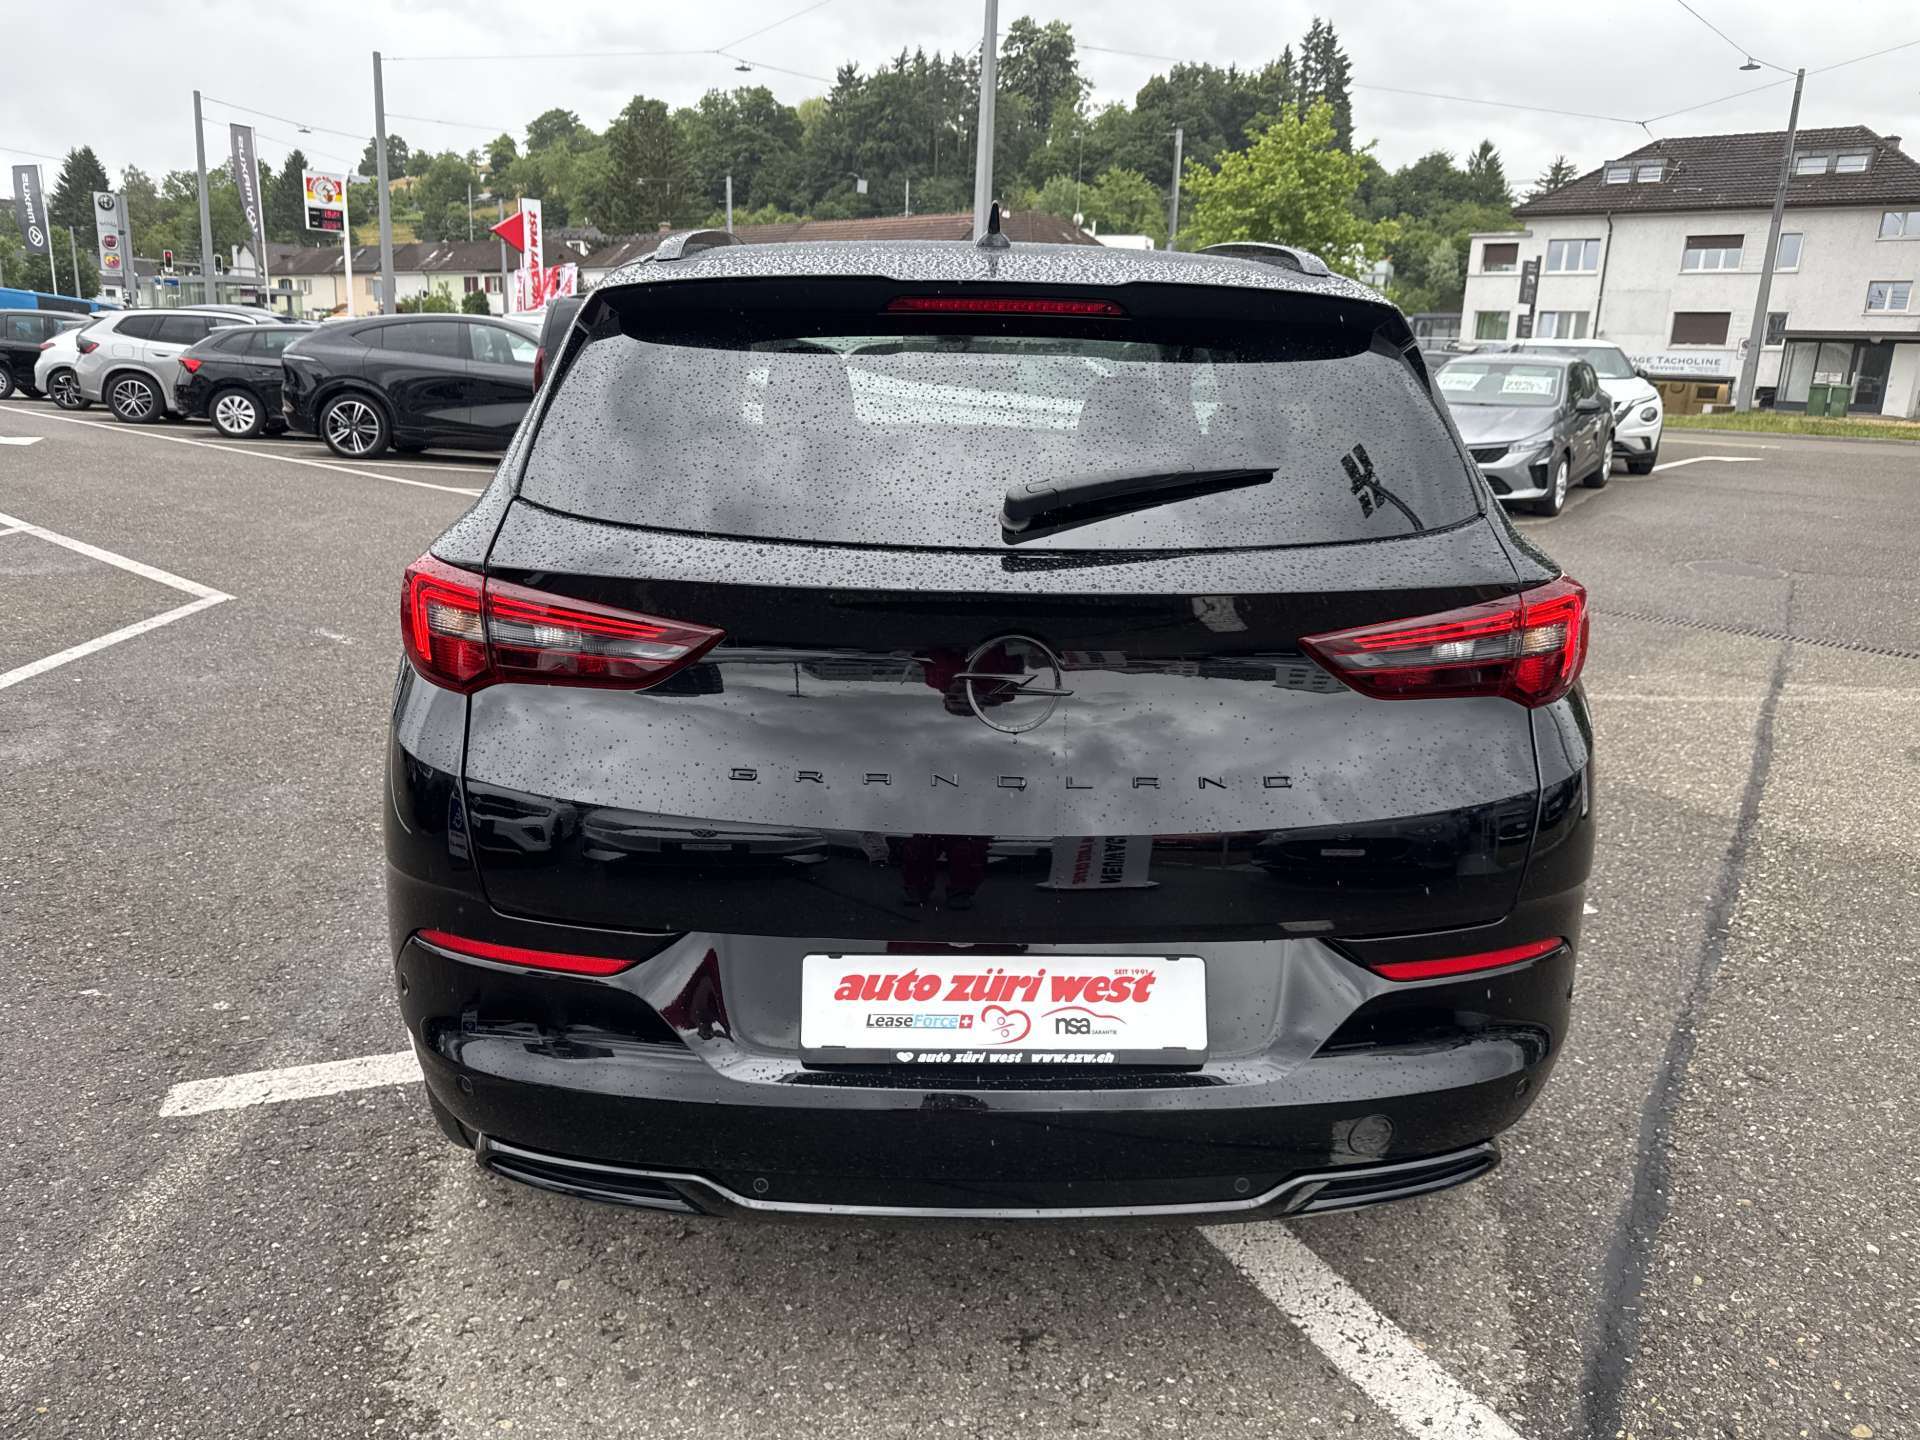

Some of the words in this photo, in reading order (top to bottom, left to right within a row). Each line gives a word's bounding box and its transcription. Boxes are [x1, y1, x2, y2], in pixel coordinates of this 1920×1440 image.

[1656, 355, 1721, 366] TACHOLINE
[729, 767, 1293, 791] GRANDLAND
[834, 968, 942, 1001] auto
[942, 968, 1046, 1002] züri
[1050, 970, 1156, 1003] west
[866, 1014, 958, 1028] LeaseForce
[1055, 1018, 1091, 1035] nsa
[917, 1052, 951, 1063] auto
[953, 1052, 986, 1063] züri
[989, 1052, 1023, 1063] west
[1031, 1052, 1115, 1064] www.azw.ch
